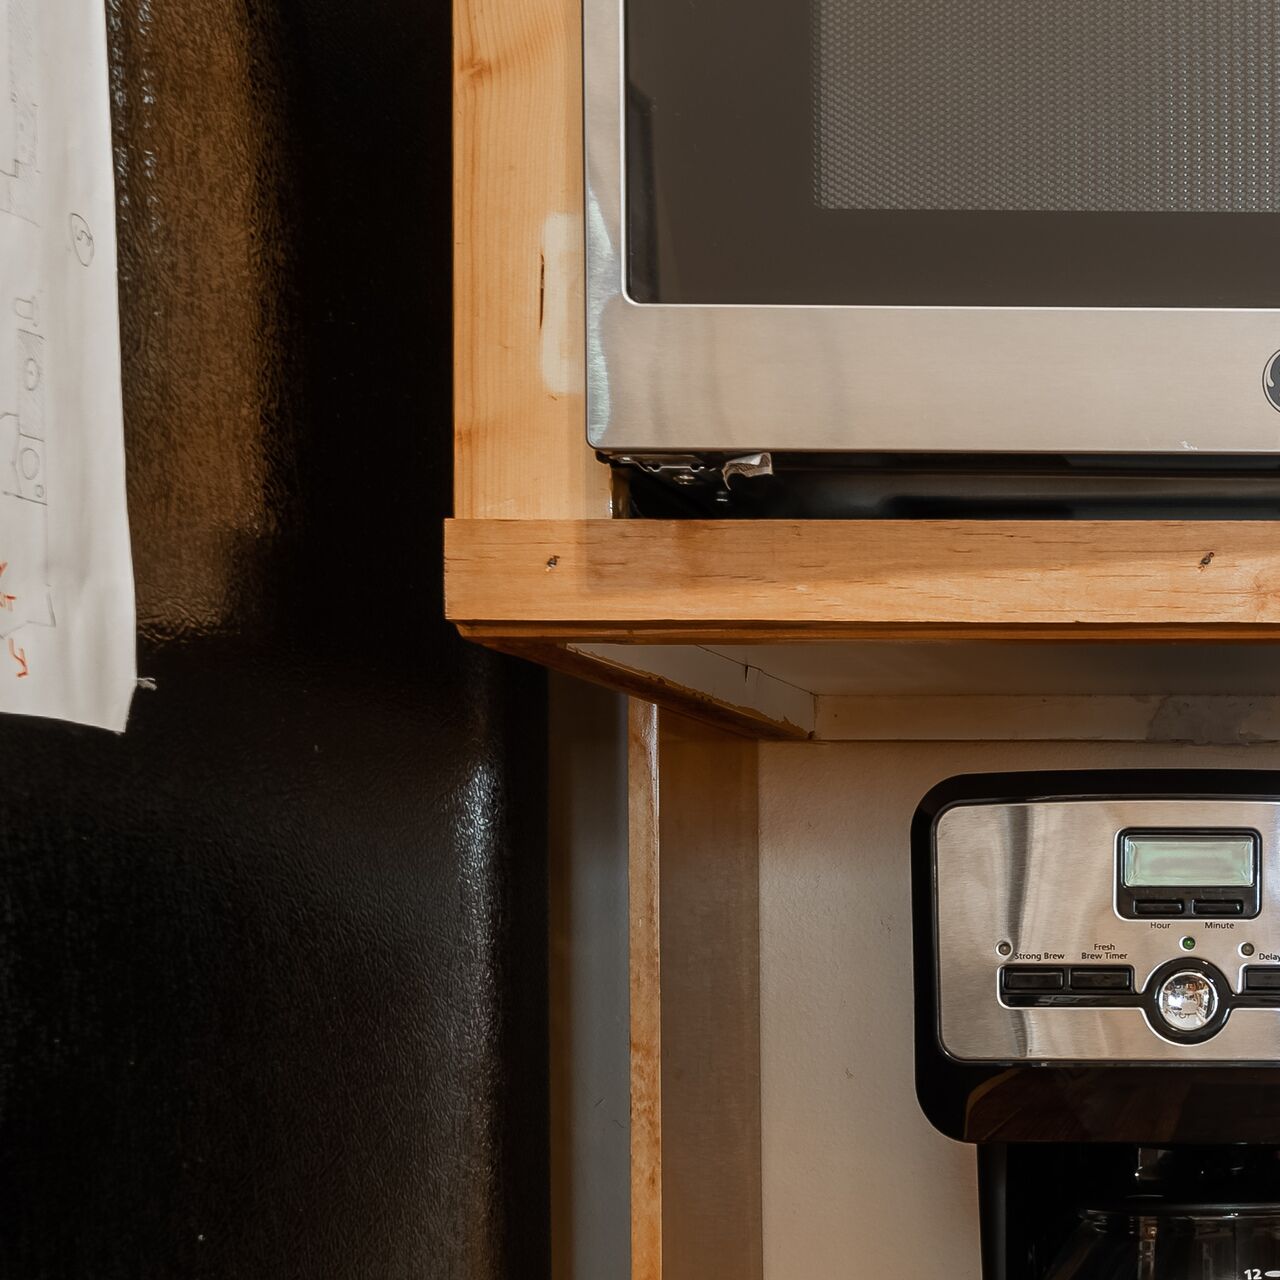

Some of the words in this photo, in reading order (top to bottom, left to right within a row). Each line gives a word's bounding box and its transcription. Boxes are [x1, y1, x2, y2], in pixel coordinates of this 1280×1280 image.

[1094, 943, 1115, 951] Fresh
[1014, 952, 1041, 962] Strong
[1043, 952, 1065, 960] Brew
[1081, 952, 1103, 960] Brew
[1105, 952, 1128, 960] Timer
[1244, 1269, 1262, 1280] 12
